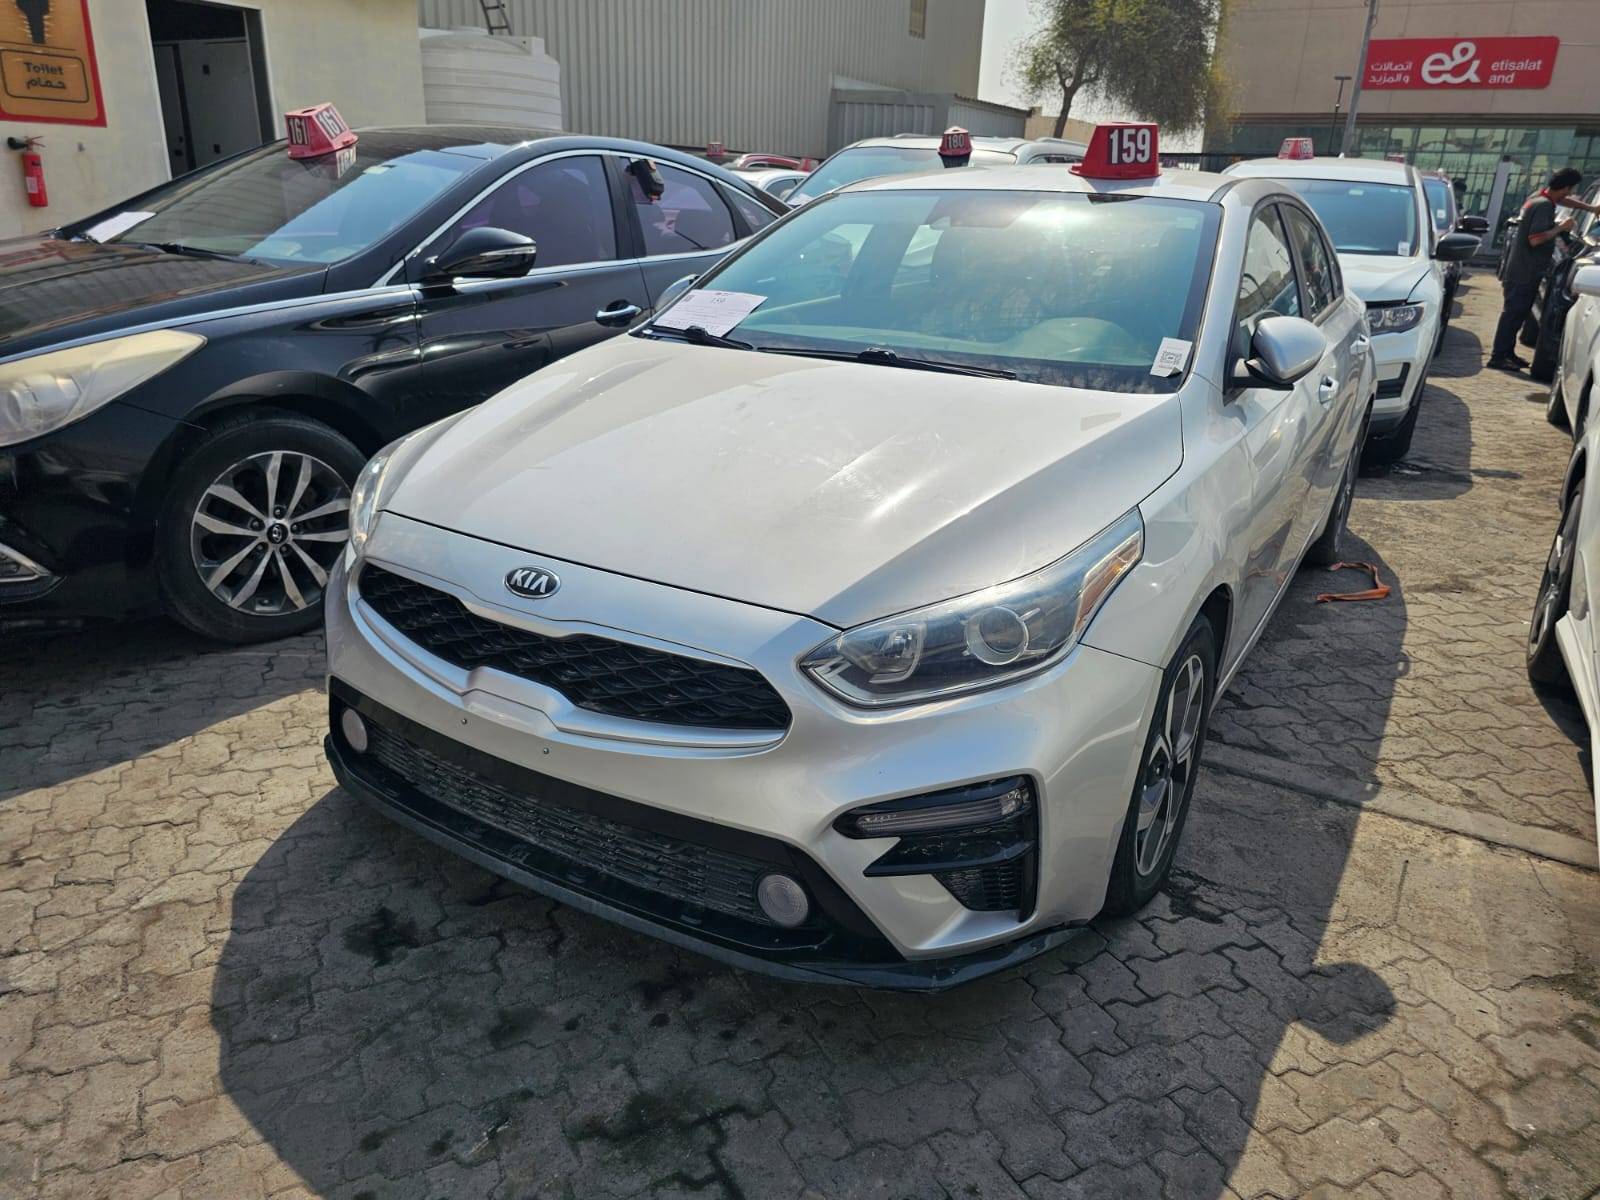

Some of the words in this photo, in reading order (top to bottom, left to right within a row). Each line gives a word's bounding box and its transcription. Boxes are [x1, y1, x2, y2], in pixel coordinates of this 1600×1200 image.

[24, 62, 64, 75] Toilet
[1370, 61, 1412, 71] اتصالات
[1421, 41, 1481, 84] e&
[1491, 59, 1542, 71] etisalat
[26, 78, 66, 90] حمام
[1368, 73, 1410, 84] والمزيد
[1488, 71, 1515, 84] and
[318, 107, 346, 140] 161
[289, 118, 308, 144] 161
[1110, 128, 1151, 164] 159
[510, 569, 549, 593] KIA
